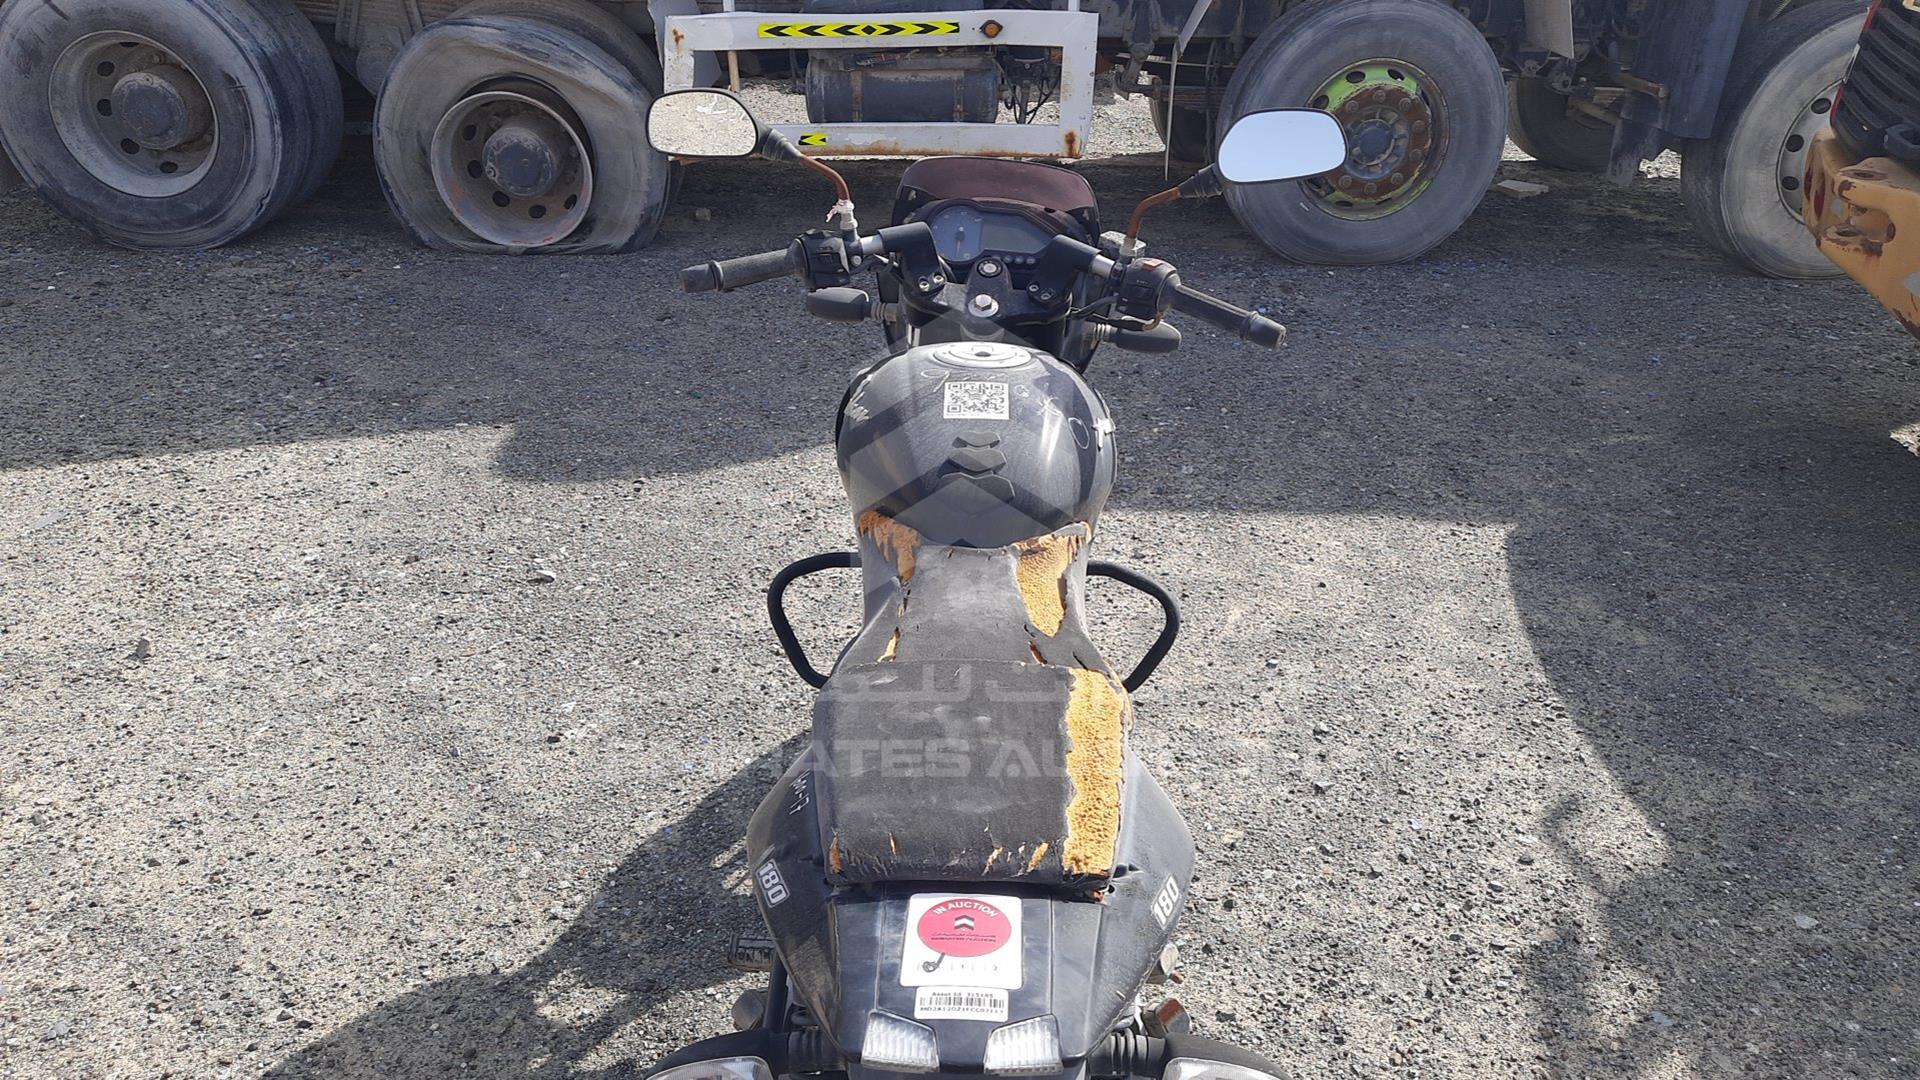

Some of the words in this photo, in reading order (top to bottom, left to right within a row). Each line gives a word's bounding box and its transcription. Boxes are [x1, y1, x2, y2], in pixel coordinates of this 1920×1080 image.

[758, 862, 787, 905] 180
[1153, 875, 1179, 926] 180
[933, 905, 948, 916] IN
[947, 901, 999, 918] AUCTION
